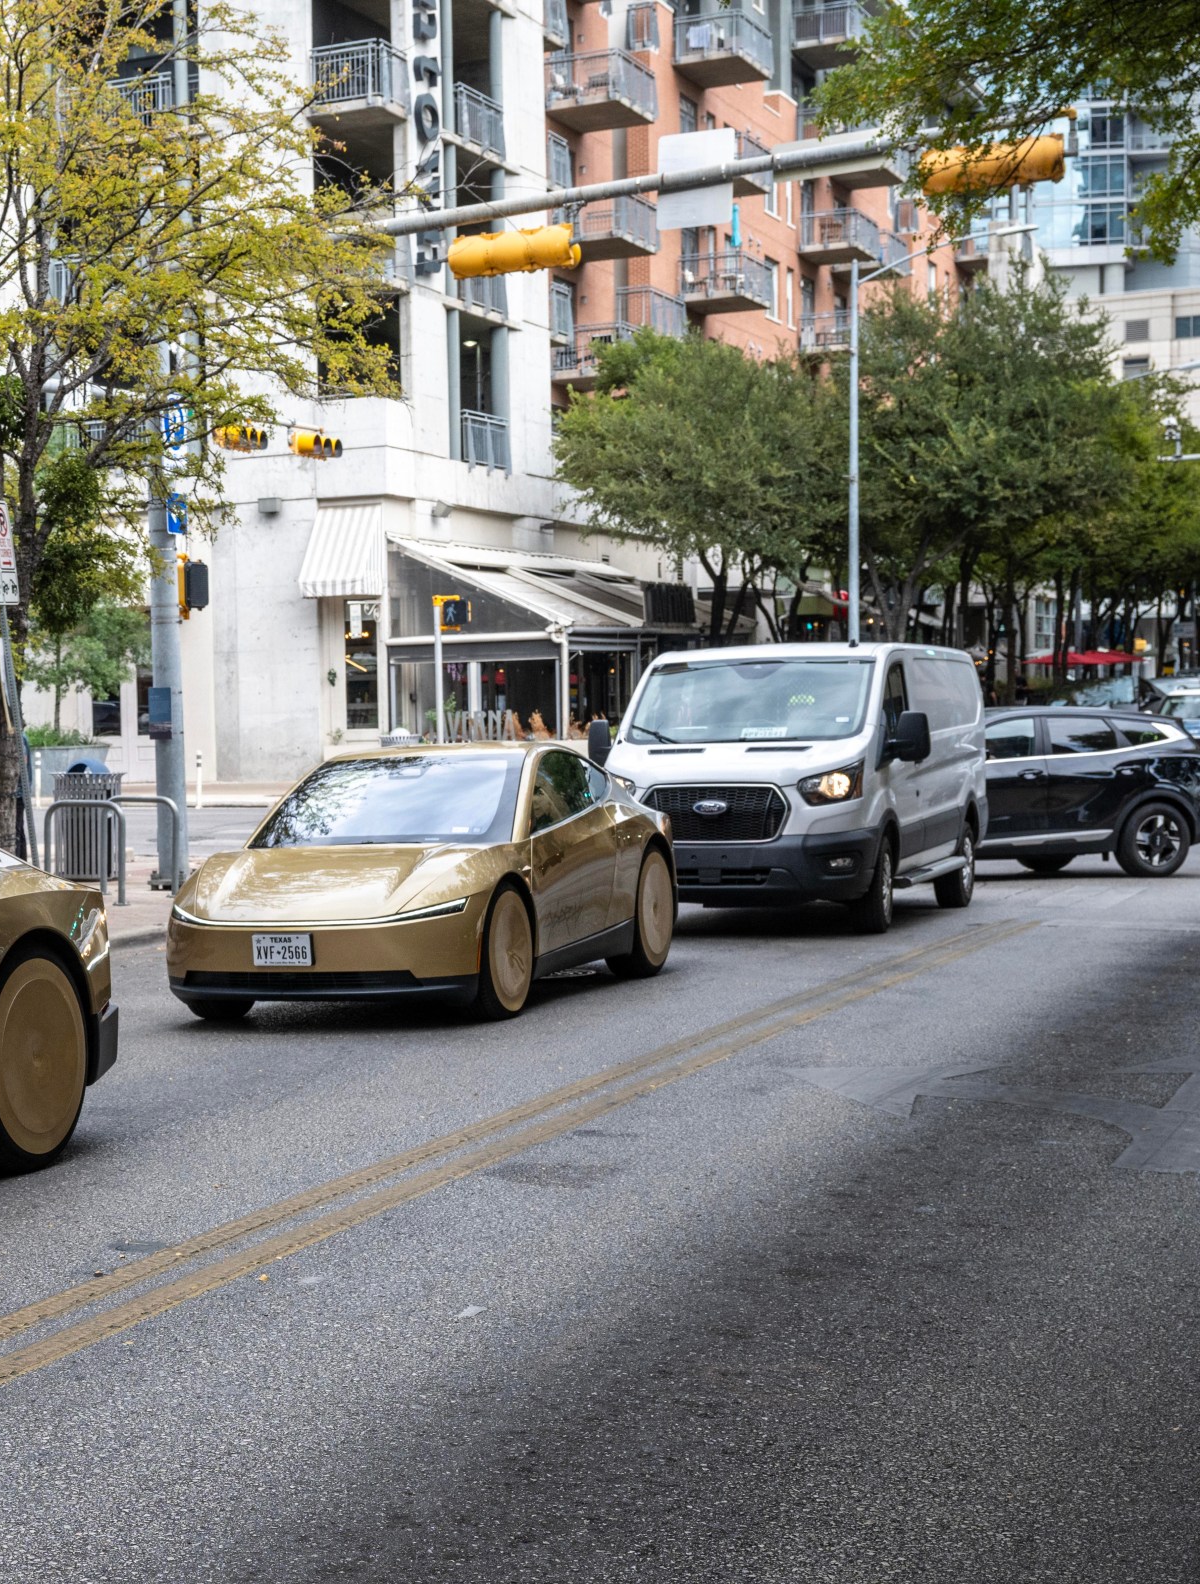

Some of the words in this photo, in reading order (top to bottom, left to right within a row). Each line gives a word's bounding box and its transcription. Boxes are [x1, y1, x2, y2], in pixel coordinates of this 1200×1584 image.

[269, 936, 292, 944] TEXAS
[256, 945, 275, 960] XVF
[281, 945, 307, 960] 2566
